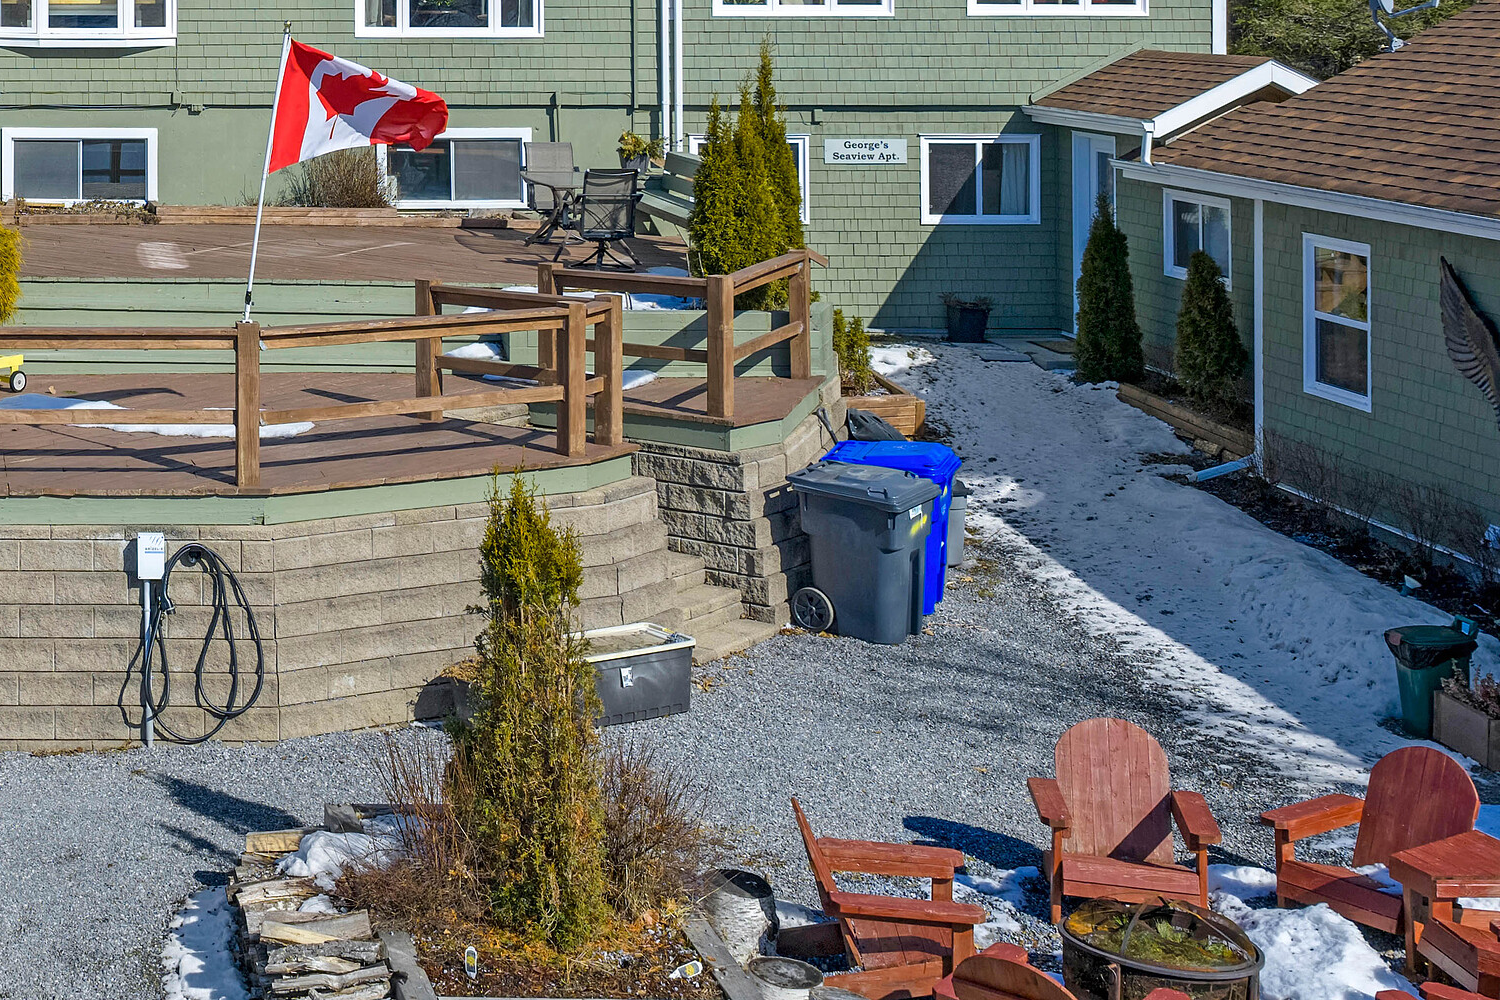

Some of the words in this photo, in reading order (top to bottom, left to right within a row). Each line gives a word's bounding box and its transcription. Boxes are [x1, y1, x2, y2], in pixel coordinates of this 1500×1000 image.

[843, 140, 889, 151] George's
[832, 152, 875, 160] Seaview
[878, 152, 900, 162] Apt.
